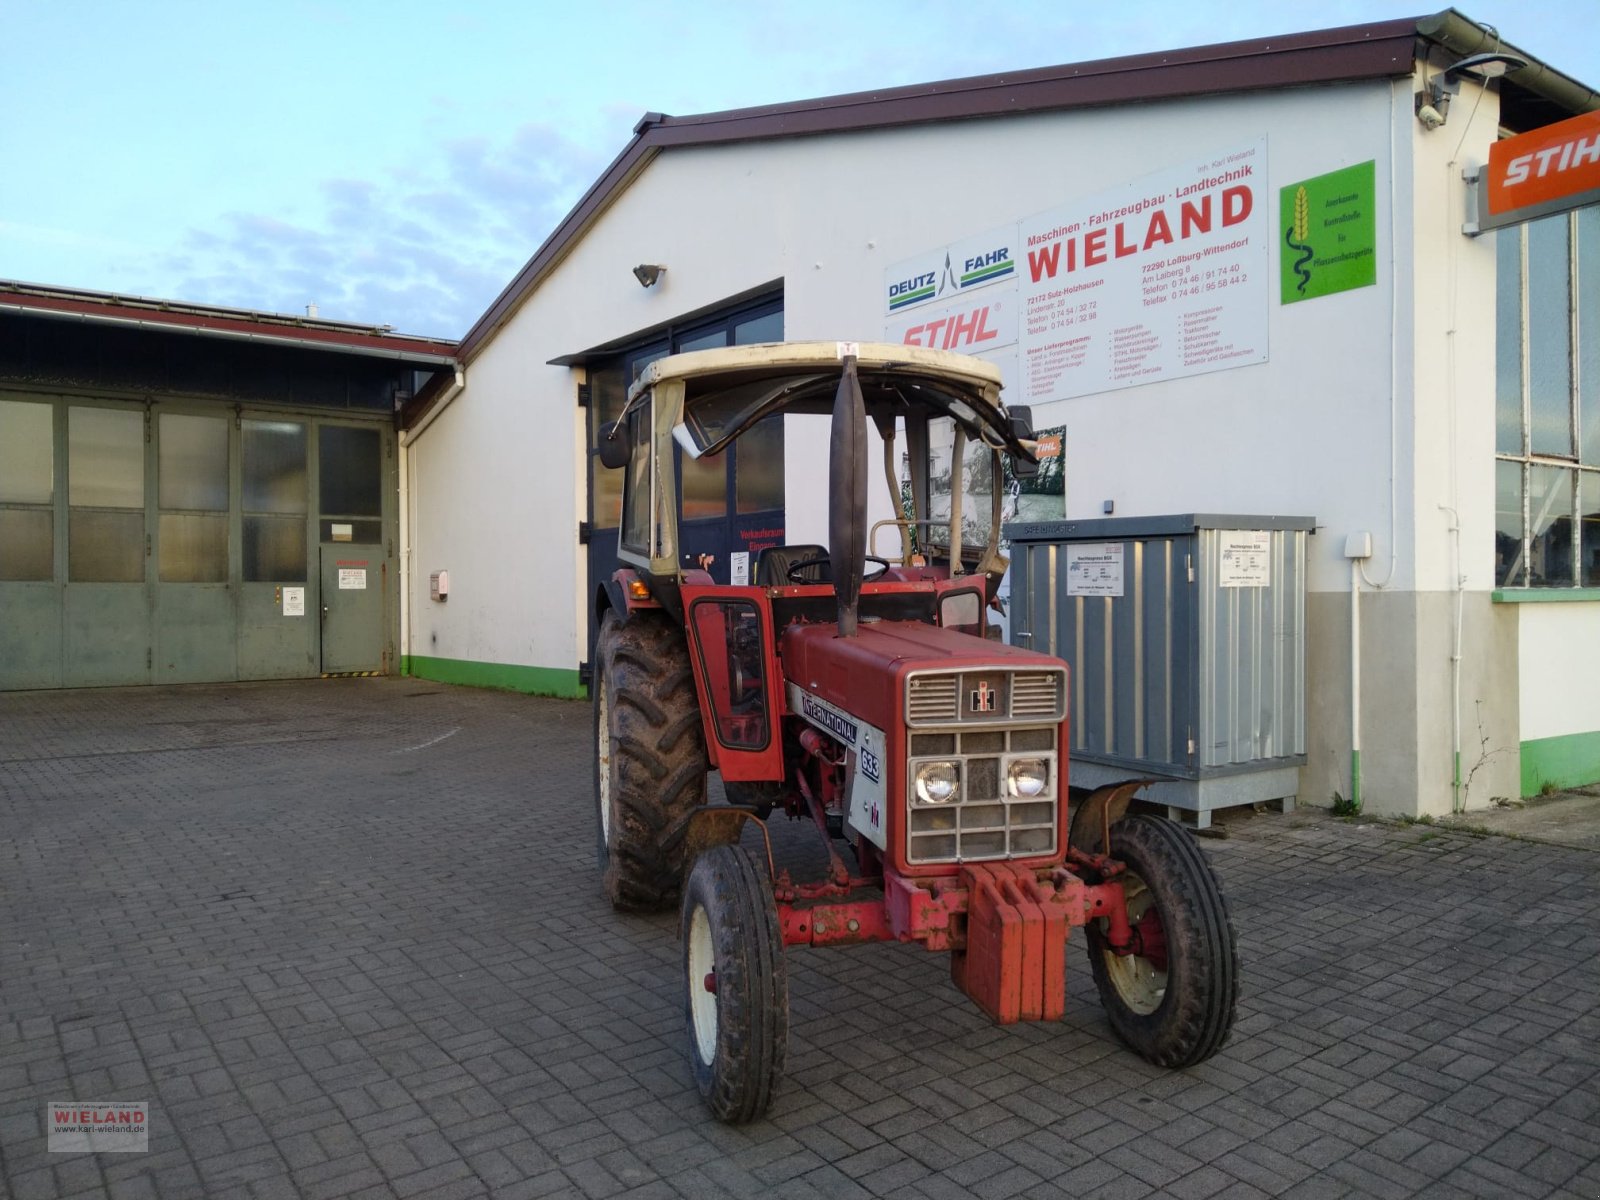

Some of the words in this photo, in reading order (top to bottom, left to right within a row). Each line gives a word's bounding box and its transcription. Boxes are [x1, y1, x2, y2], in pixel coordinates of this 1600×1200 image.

[1211, 158, 1225, 169] Karl
[1226, 148, 1255, 164] Wieland
[1027, 222, 1080, 247] Maschinen
[1089, 194, 1165, 227] Fahrzeugbau
[1176, 165, 1253, 198] Landtechnik
[1028, 185, 1253, 284] WIELAND
[1142, 260, 1165, 273] 72290
[1167, 237, 1249, 266] Loßburg-Wittendorf
[889, 271, 935, 297] DEUTZ
[965, 247, 1008, 272] FAHR
[1142, 282, 1168, 295] Telefon
[1179, 277, 1187, 286] 74
[1206, 270, 1215, 279] 91
[1217, 267, 1227, 277] 74
[1229, 263, 1240, 273] 40
[1142, 276, 1154, 284] Am
[1027, 294, 1046, 305] 72172
[1047, 279, 1104, 300] Sulz-Holzhausen
[1142, 295, 1167, 307] Telefax
[1179, 289, 1187, 298] 74
[1190, 286, 1199, 294] 46
[1206, 282, 1215, 291] 95
[1217, 279, 1228, 288] 58
[1229, 276, 1240, 285] 44
[1241, 274, 1247, 282] 2
[1027, 302, 1056, 315] Lindenstr.
[1057, 299, 1065, 308] 20
[1027, 314, 1048, 325] Telefon
[1057, 310, 1064, 318] 74
[1066, 307, 1074, 315] 54
[1079, 303, 1087, 312] 32
[1089, 301, 1097, 309] 72
[903, 306, 998, 350] STIHL
[1027, 326, 1047, 335] Telefax
[1057, 320, 1064, 328] 74
[1066, 318, 1074, 326] 54
[1079, 314, 1087, 322] 32
[1037, 441, 1056, 453] TIHL
[740, 527, 785, 540] Verkaufsraum
[802, 695, 857, 744] INTERNATIONAL
[861, 749, 880, 779] 633
